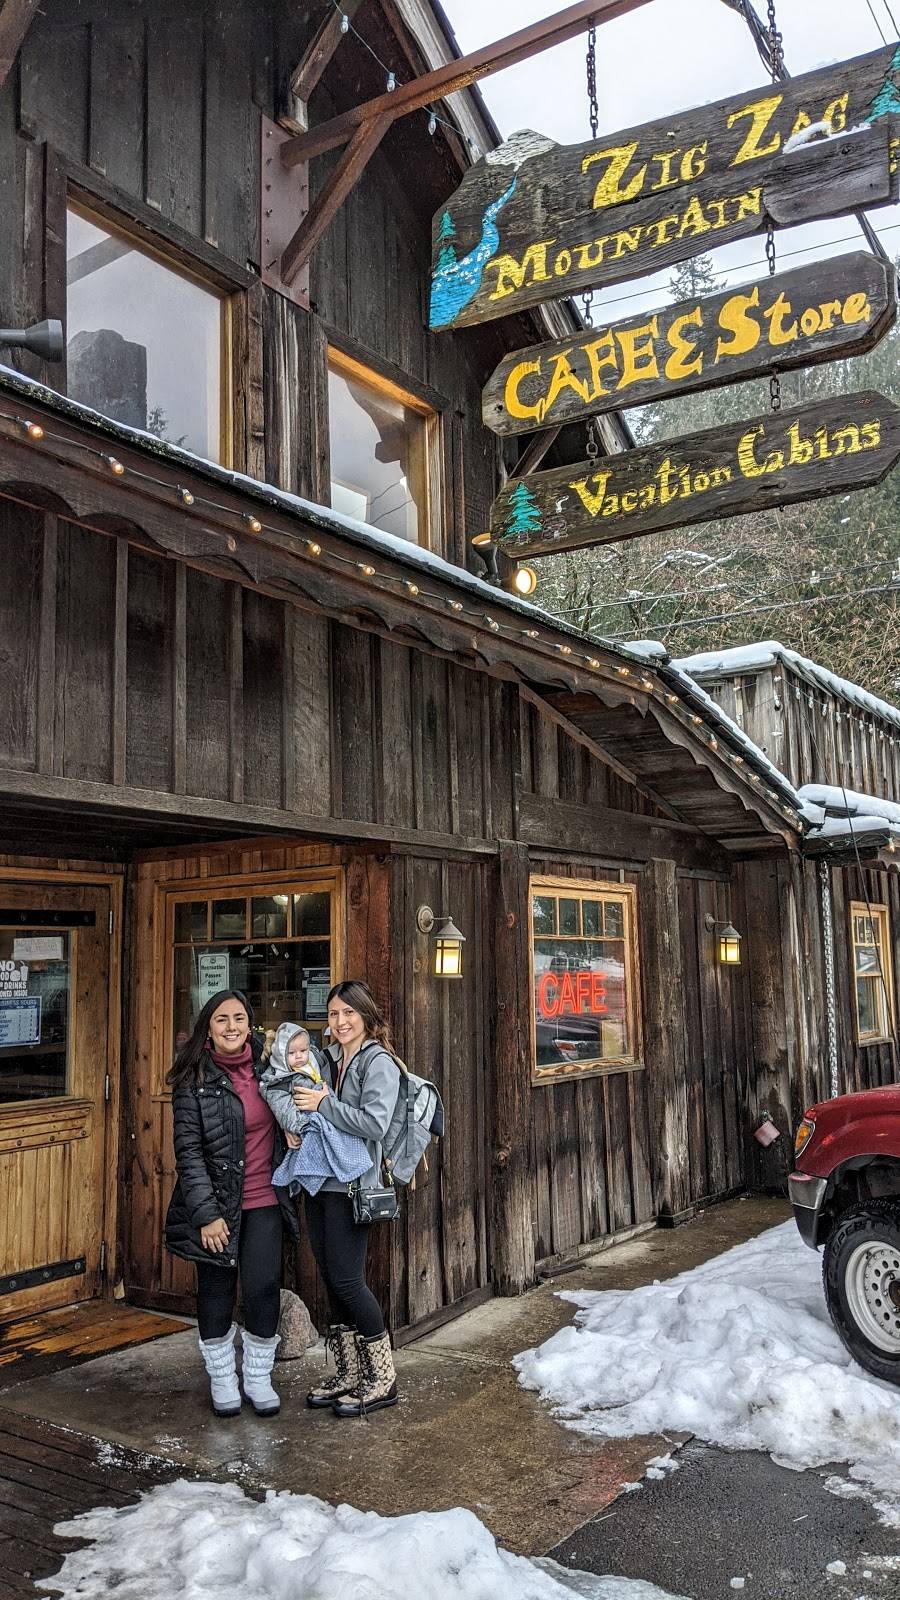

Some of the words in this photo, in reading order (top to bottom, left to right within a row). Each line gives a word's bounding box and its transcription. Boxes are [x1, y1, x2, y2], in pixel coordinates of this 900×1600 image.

[485, 187, 764, 301] MOUNTAIN
[570, 456, 732, 517] Vacation
[738, 419, 881, 479] Cabins
[4, 981, 26, 990] DRINKS
[539, 971, 608, 1019] CAFE
